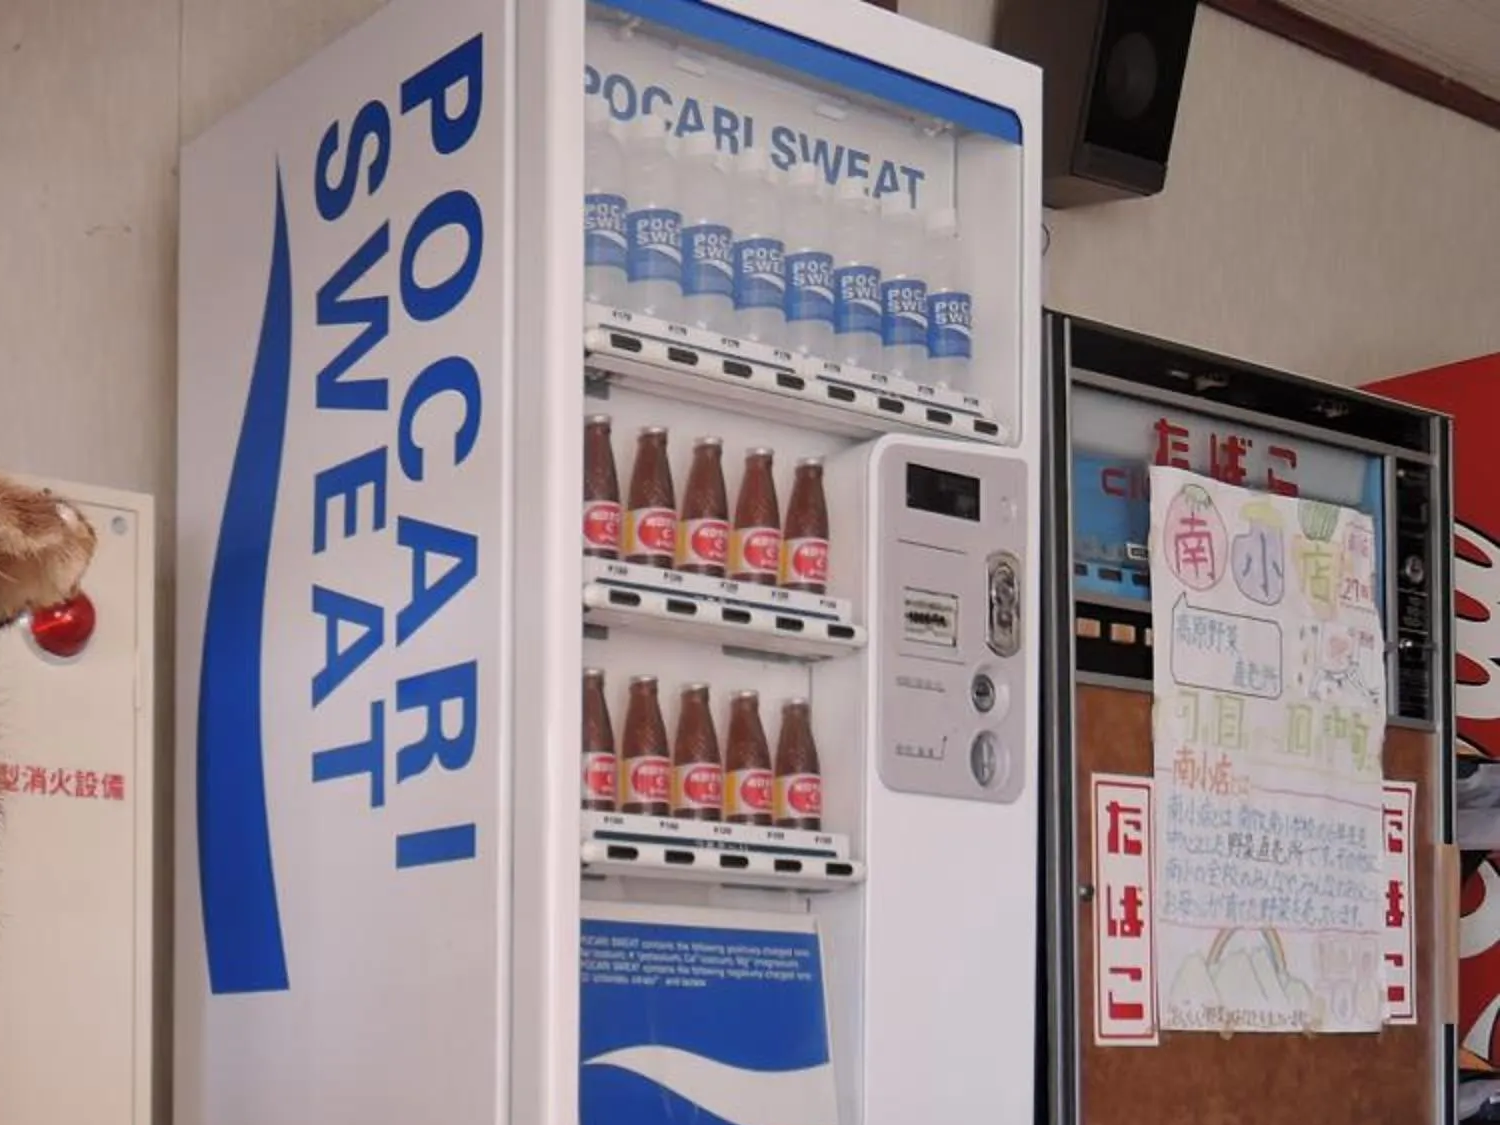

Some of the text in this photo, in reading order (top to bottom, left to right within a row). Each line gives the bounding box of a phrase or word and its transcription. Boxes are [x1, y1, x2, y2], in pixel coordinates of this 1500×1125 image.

[584, 64, 925, 210] POCARI SWEAT
[311, 99, 391, 810] SWEAT
[395, 32, 484, 870] POCARI
[1154, 417, 1298, 497] たばこ
[1105, 800, 1145, 1021] たばこ
